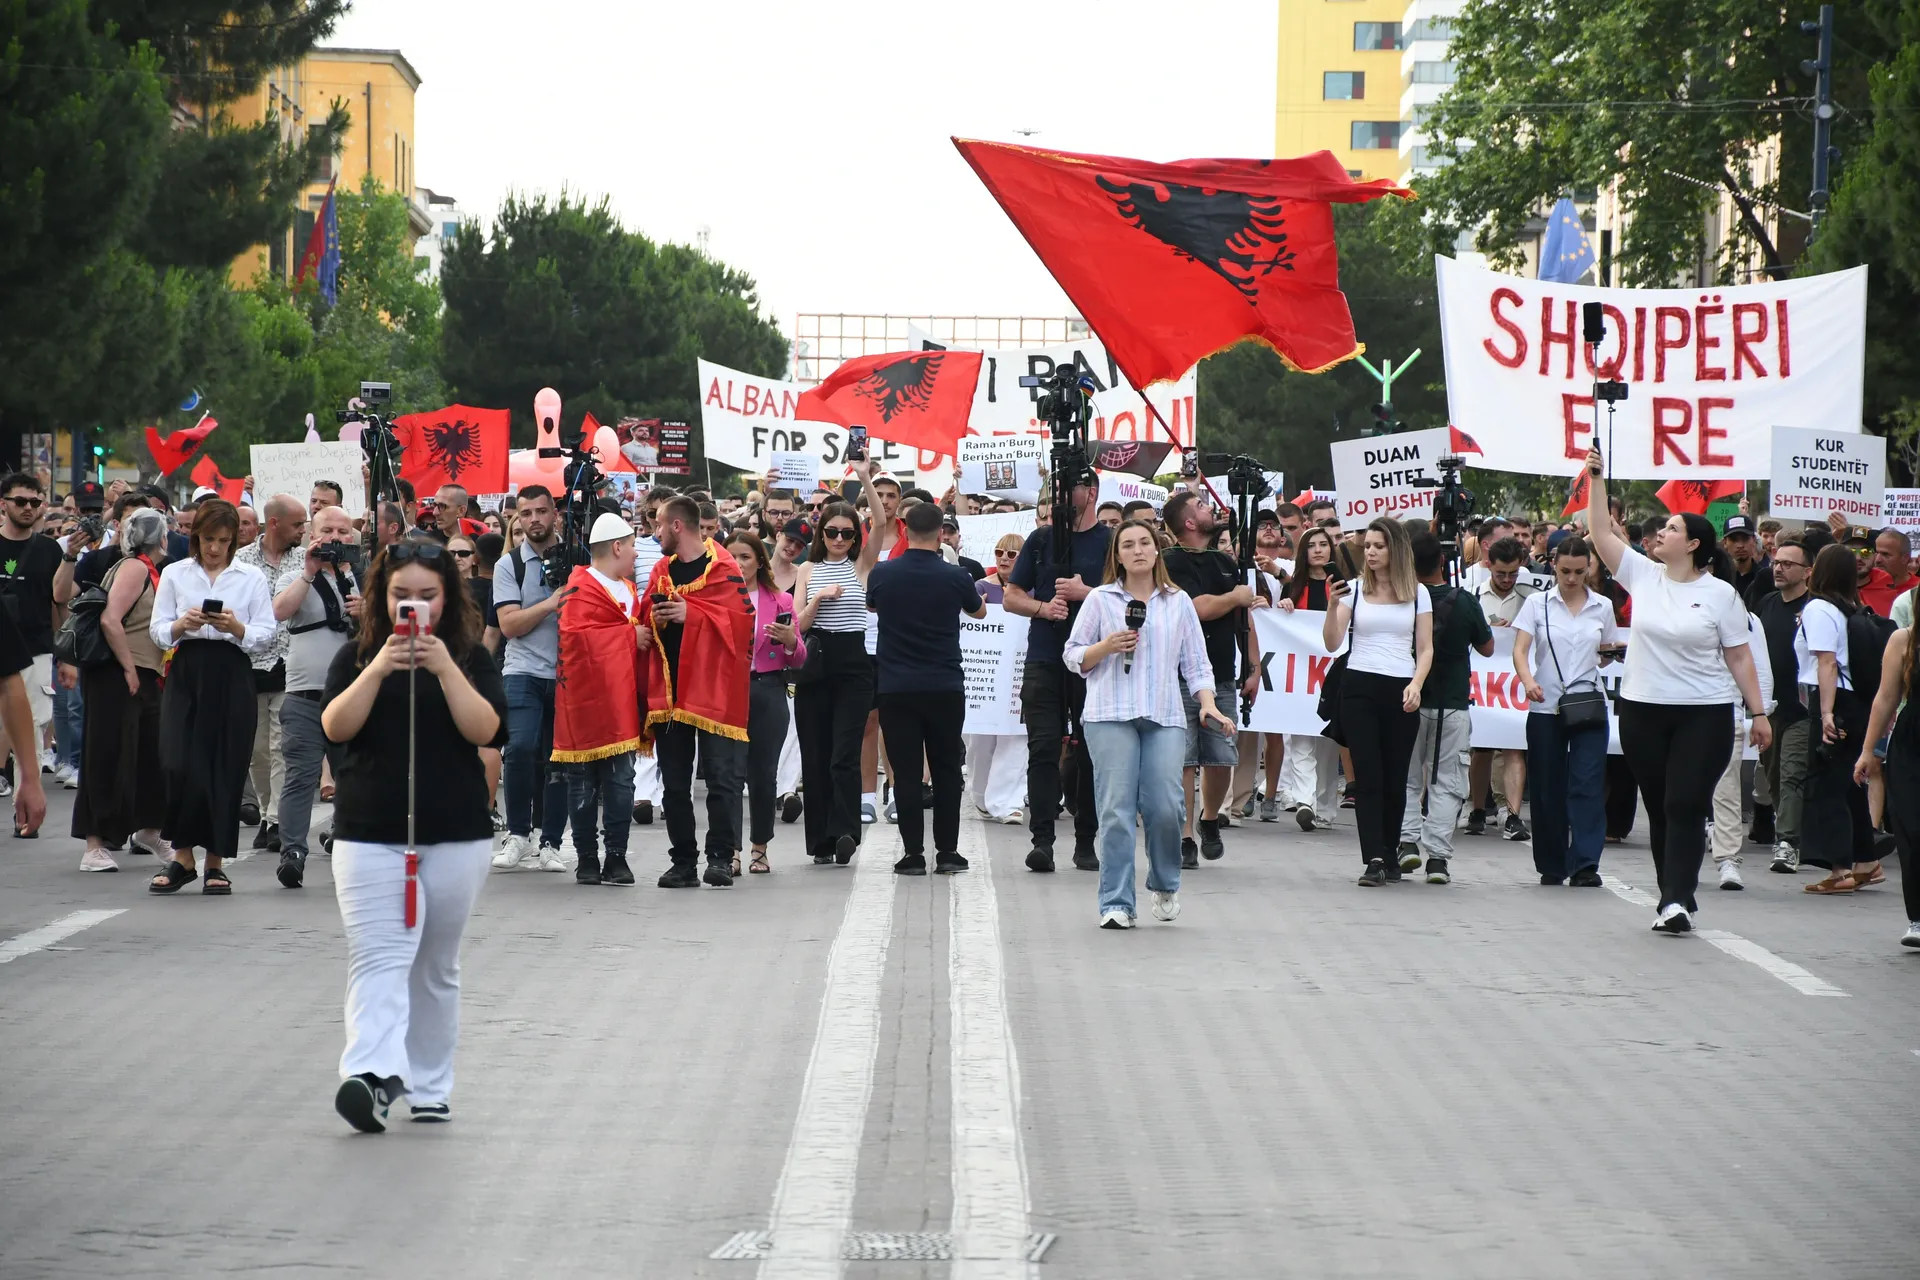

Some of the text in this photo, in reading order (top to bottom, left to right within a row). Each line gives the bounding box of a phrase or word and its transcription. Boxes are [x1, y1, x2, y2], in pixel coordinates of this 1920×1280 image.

[1482, 287, 1791, 383] SHQIPËRI
[705, 376, 802, 418] ALBAN
[1562, 393, 1735, 467] E RE
[752, 426, 807, 457] FOR
[966, 442, 996, 450] Rama
[1815, 438, 1844, 453] KUR
[962, 452, 1003, 461] Berisha
[1364, 445, 1420, 466] DUAM
[1791, 456, 1869, 475] STUDENTËT
[1369, 467, 1425, 489] SHTET
[1798, 476, 1862, 494] NGRIHEN
[1119, 483, 1139, 498] AMA
[1346, 499, 1369, 517] JO
[1774, 494, 1881, 517] SHTETI DRIDHET
[1896, 509, 1919, 517] DUHET
[1889, 517, 1920, 525] LAGJE
[961, 623, 1005, 633] POSHTË
[1285, 653, 1296, 693] I
